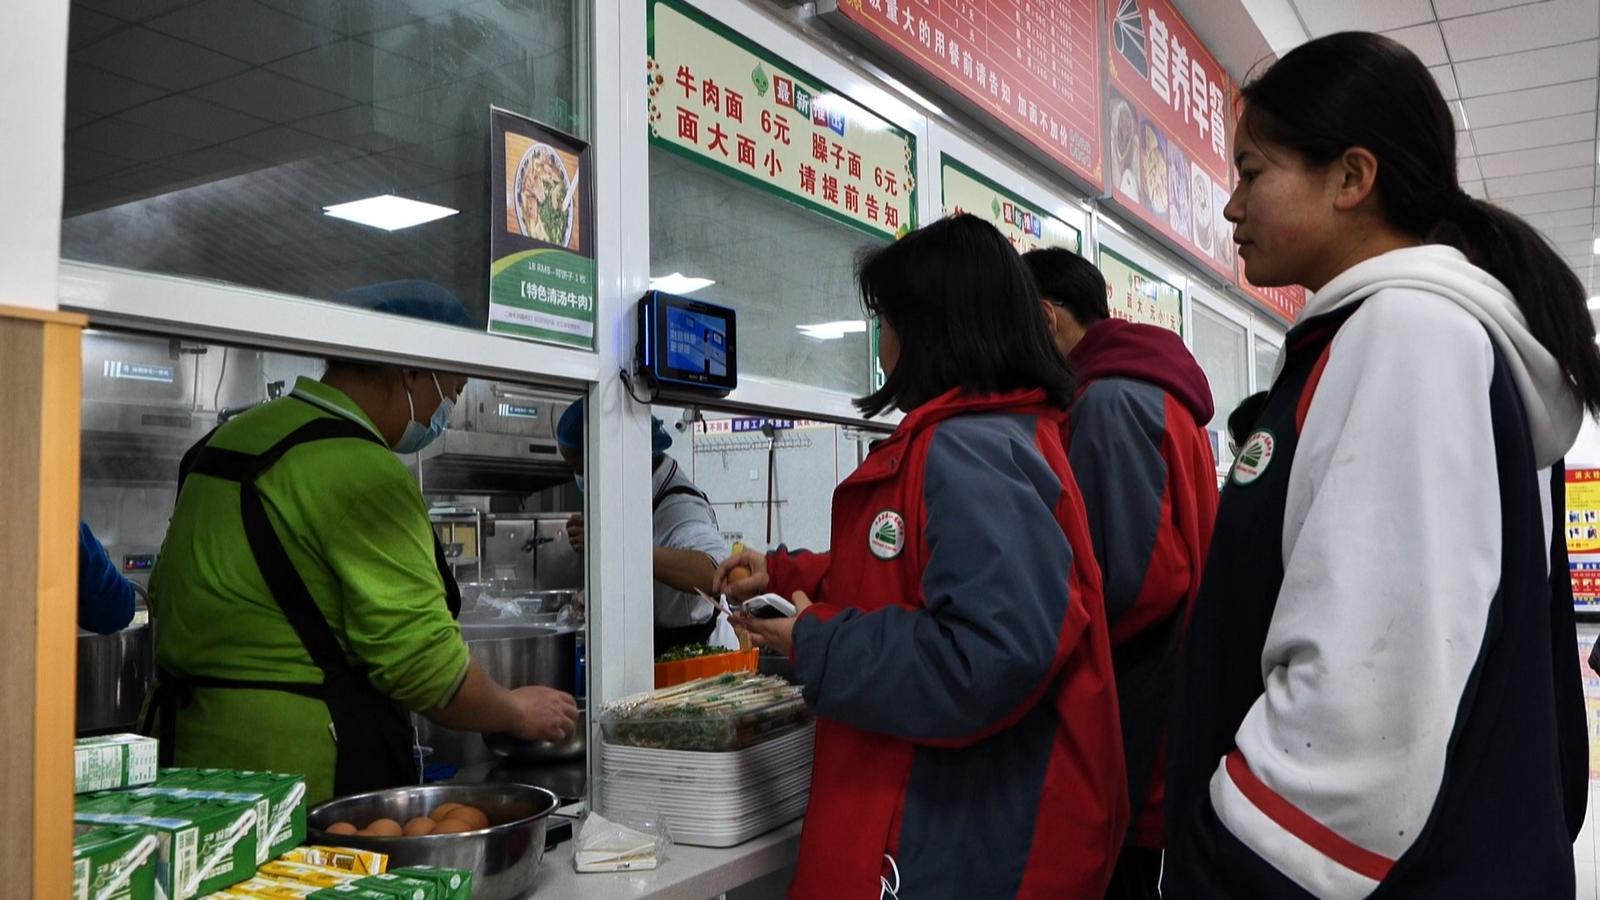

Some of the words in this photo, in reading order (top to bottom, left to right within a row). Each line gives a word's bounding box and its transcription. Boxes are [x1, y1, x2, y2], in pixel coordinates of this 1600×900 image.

[775, 79, 845, 134] 最新推出
[1017, 92, 1068, 148] 加面不加价
[1148, 7, 1226, 162] 营养早餐
[675, 65, 744, 124] 牛肉面
[760, 109, 791, 146] 6元
[811, 132, 862, 181] 臊子面
[874, 165, 898, 197] 6元
[675, 104, 783, 178] 面大面小
[798, 162, 899, 229] 请提前告知
[520, 280, 593, 312] 【特色清汤牛肉】
